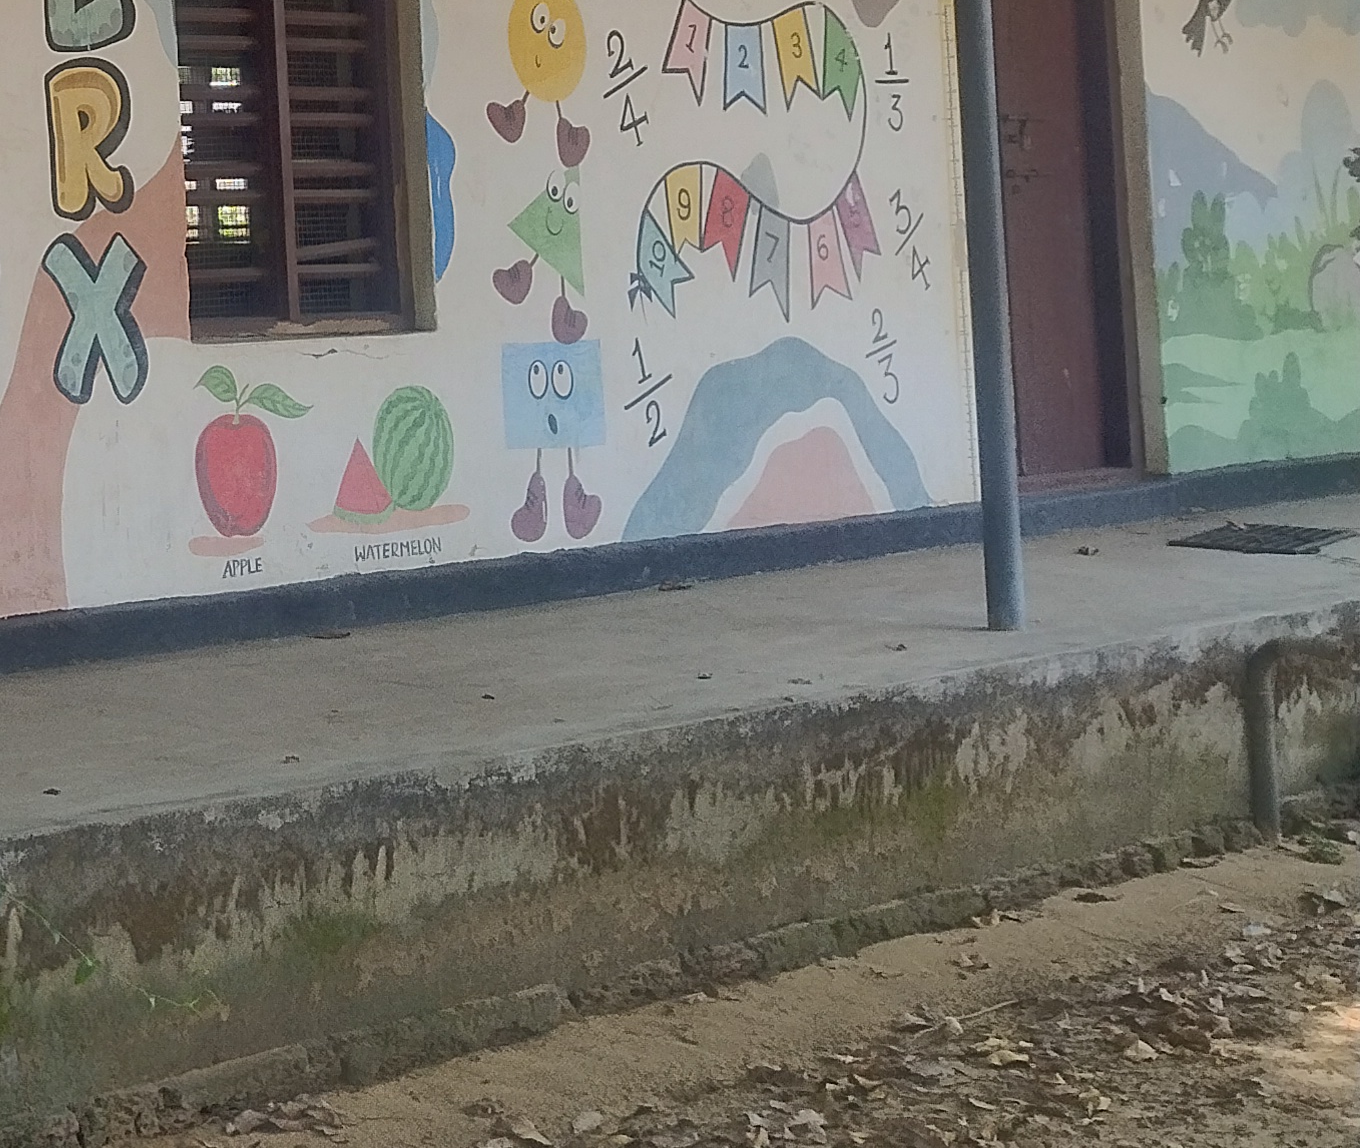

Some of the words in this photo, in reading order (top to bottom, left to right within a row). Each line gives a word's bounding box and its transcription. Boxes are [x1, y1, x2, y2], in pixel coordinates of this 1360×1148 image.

[685, 25, 698, 51] 1
[738, 45, 749, 69] 2
[792, 32, 804, 58] 3
[835, 49, 847, 72] 4
[45, 58, 135, 220] R
[650, 239, 667, 277] 10
[677, 188, 692, 221] 9
[721, 196, 735, 228] 8
[766, 233, 780, 263] 7
[817, 233, 830, 261] 6
[43, 233, 147, 404] X
[222, 557, 264, 580] APPLE
[354, 537, 443, 562] WATERMELON
